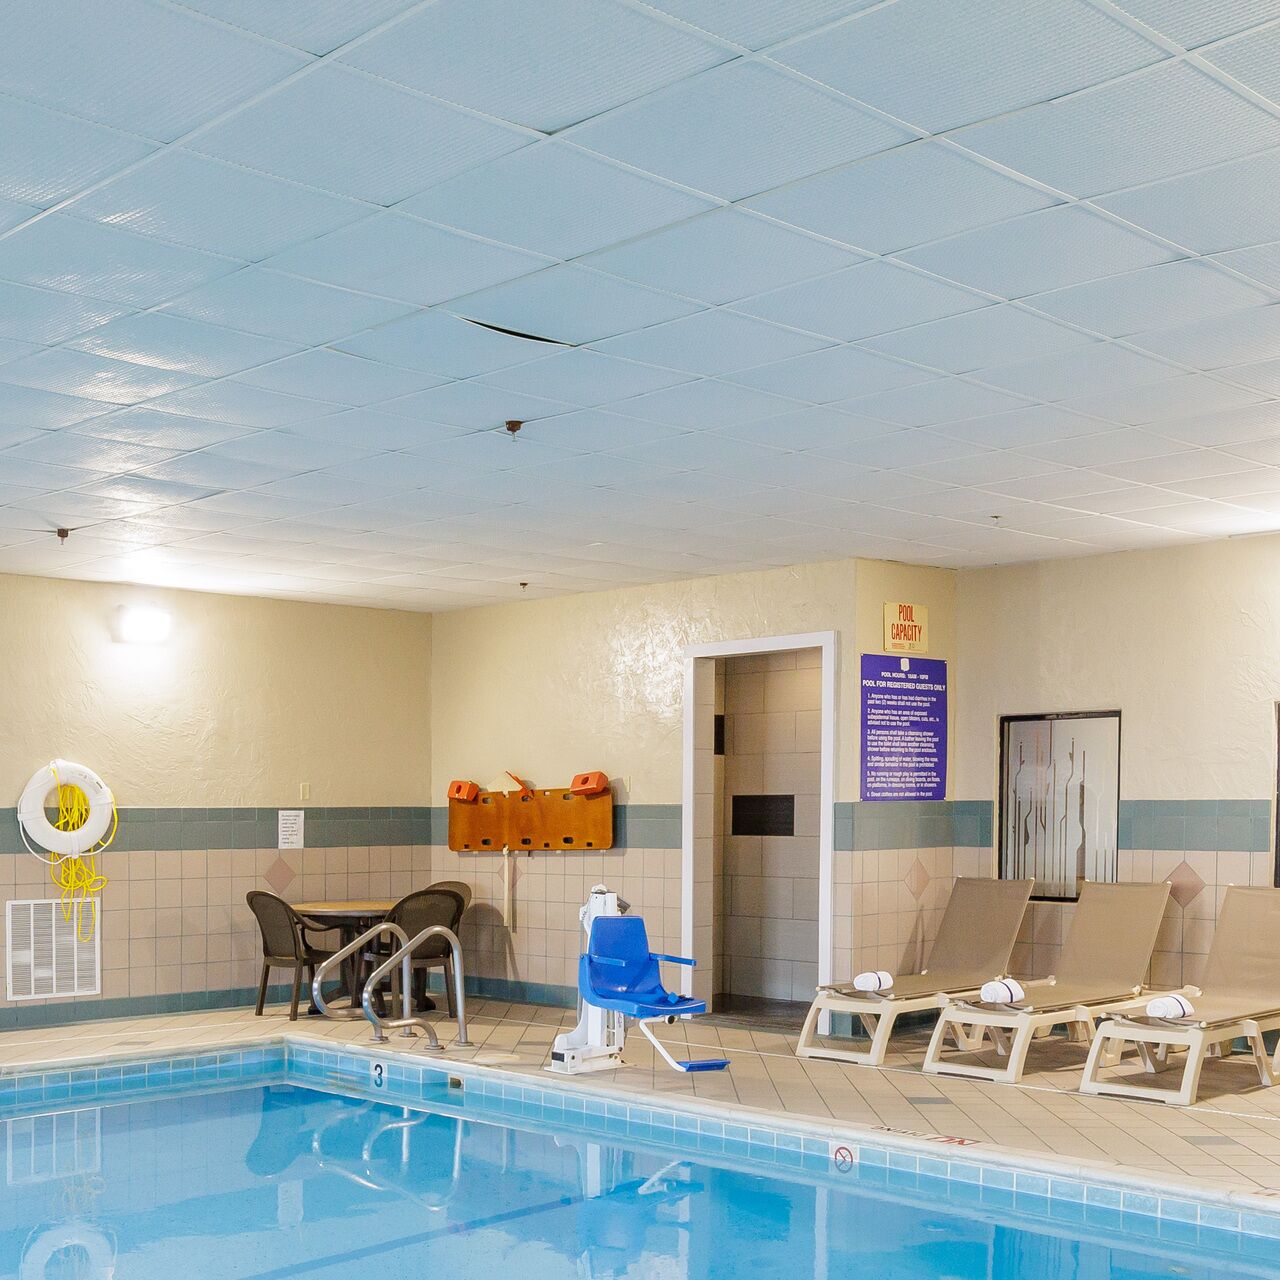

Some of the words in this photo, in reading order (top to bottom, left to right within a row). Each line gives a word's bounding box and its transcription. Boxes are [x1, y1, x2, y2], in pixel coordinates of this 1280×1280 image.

[898, 604, 914, 622] POOL
[891, 623, 922, 642] CAPACITY
[374, 1063, 383, 1087] 3
